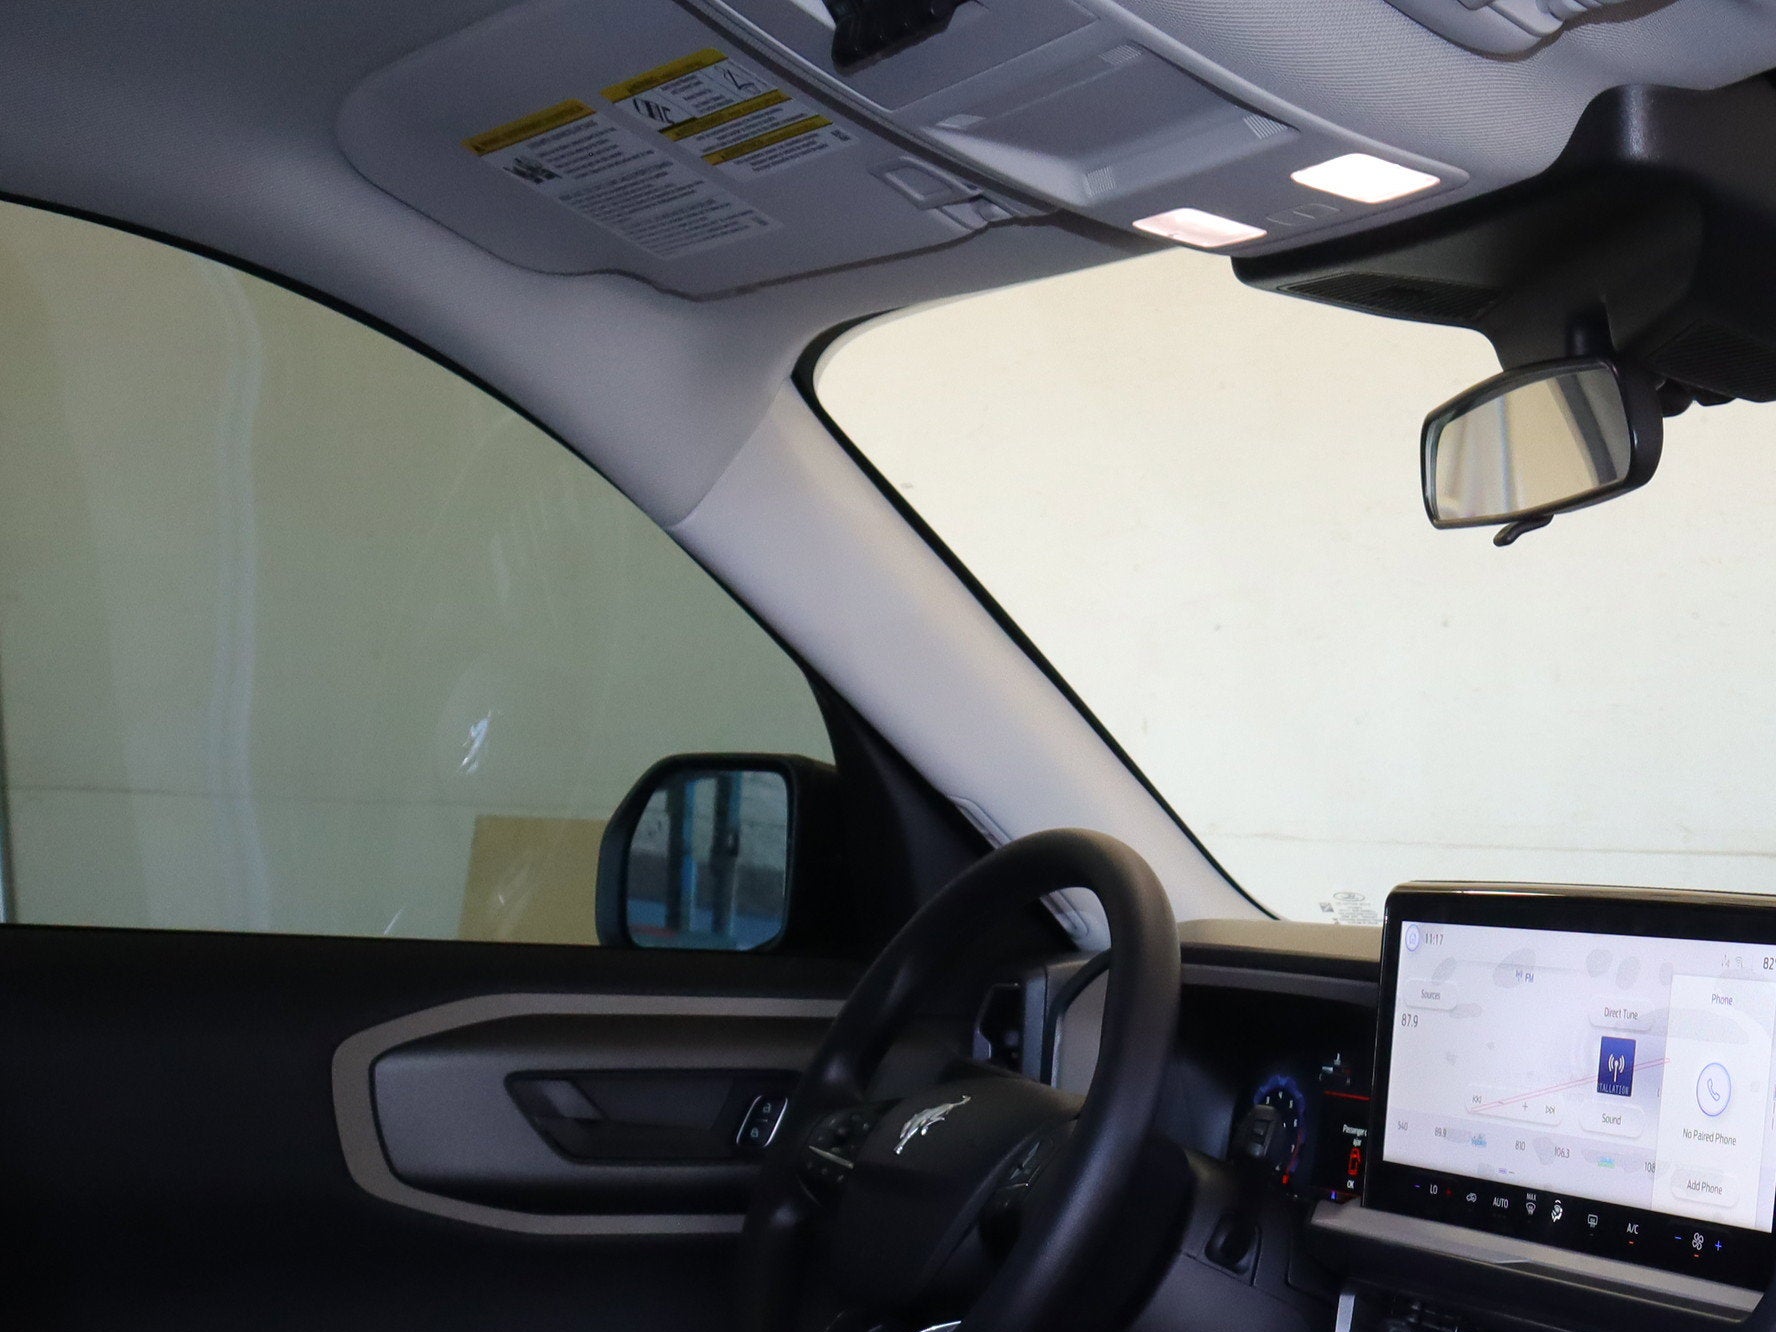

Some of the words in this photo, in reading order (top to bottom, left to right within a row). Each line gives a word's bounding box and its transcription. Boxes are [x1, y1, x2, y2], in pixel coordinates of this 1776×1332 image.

[1425, 933, 1444, 946] 11:17
[1421, 989, 1441, 1000] Sources
[1711, 993, 1733, 1006] Phone
[1604, 1006, 1622, 1018] Direct
[1623, 1008, 1638, 1020] Tune
[1401, 1013, 1419, 1028] 87.9
[1602, 1113, 1622, 1126] Sound
[1683, 1128, 1692, 1139] No
[1694, 1130, 1714, 1143] Paired
[1715, 1133, 1736, 1146] Phone
[1554, 1146, 1570, 1159] 106.3
[1687, 1179, 1700, 1191] Add
[1702, 1182, 1723, 1195] Phone
[1493, 1197, 1509, 1208] AUTO
[1626, 1222, 1639, 1235] A/C
